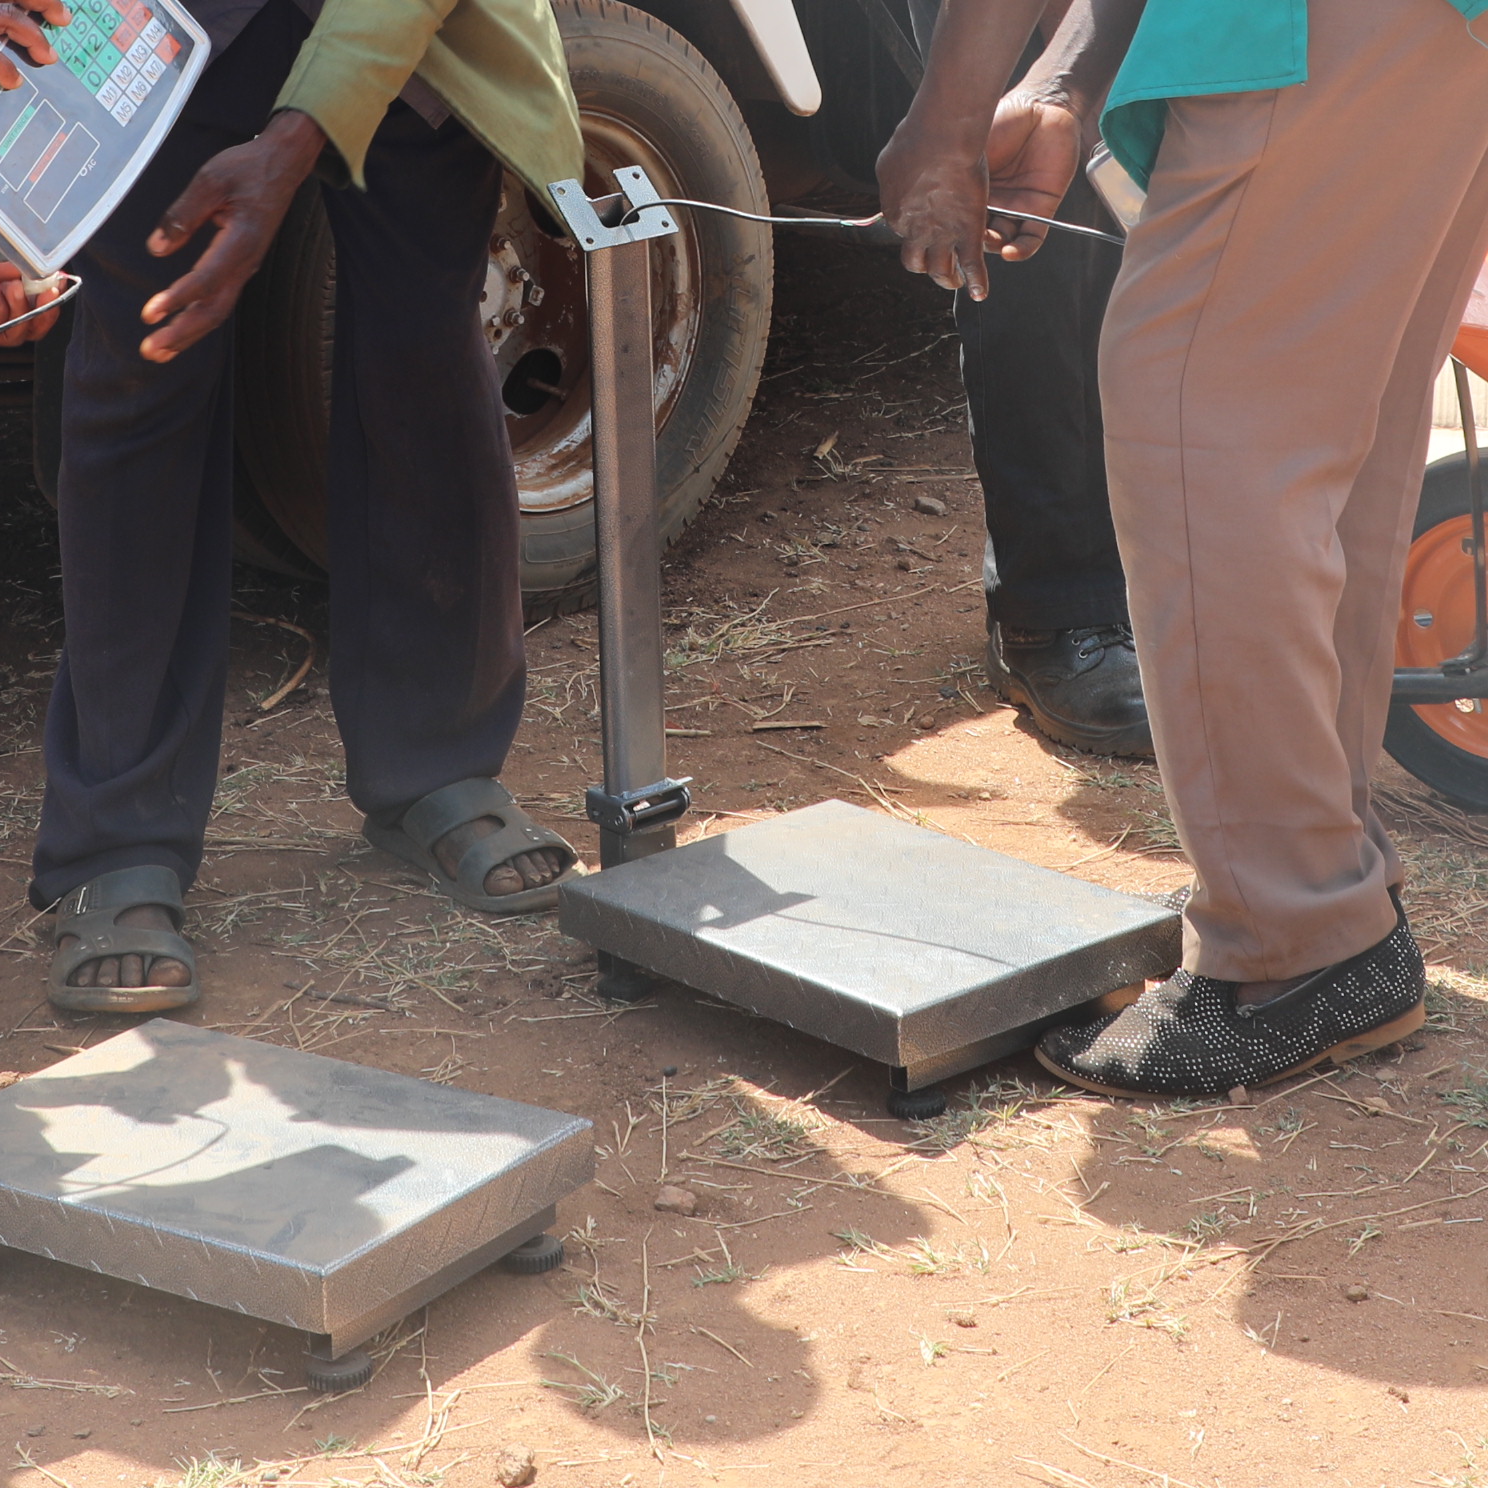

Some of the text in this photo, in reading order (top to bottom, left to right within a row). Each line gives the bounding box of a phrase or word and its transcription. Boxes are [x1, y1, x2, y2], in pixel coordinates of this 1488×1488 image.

[60, 39, 73, 54] 4
[74, 16, 88, 34] 5
[74, 54, 86, 69] 1
[87, 35, 102, 52] 2
[103, 13, 118, 30] 3
[87, 71, 101, 86] 0
[101, 23, 162, 104] M1 M2 M3 M4
[116, 59, 162, 121] M5 M6 M7
[87, 158, 97, 172] AC
